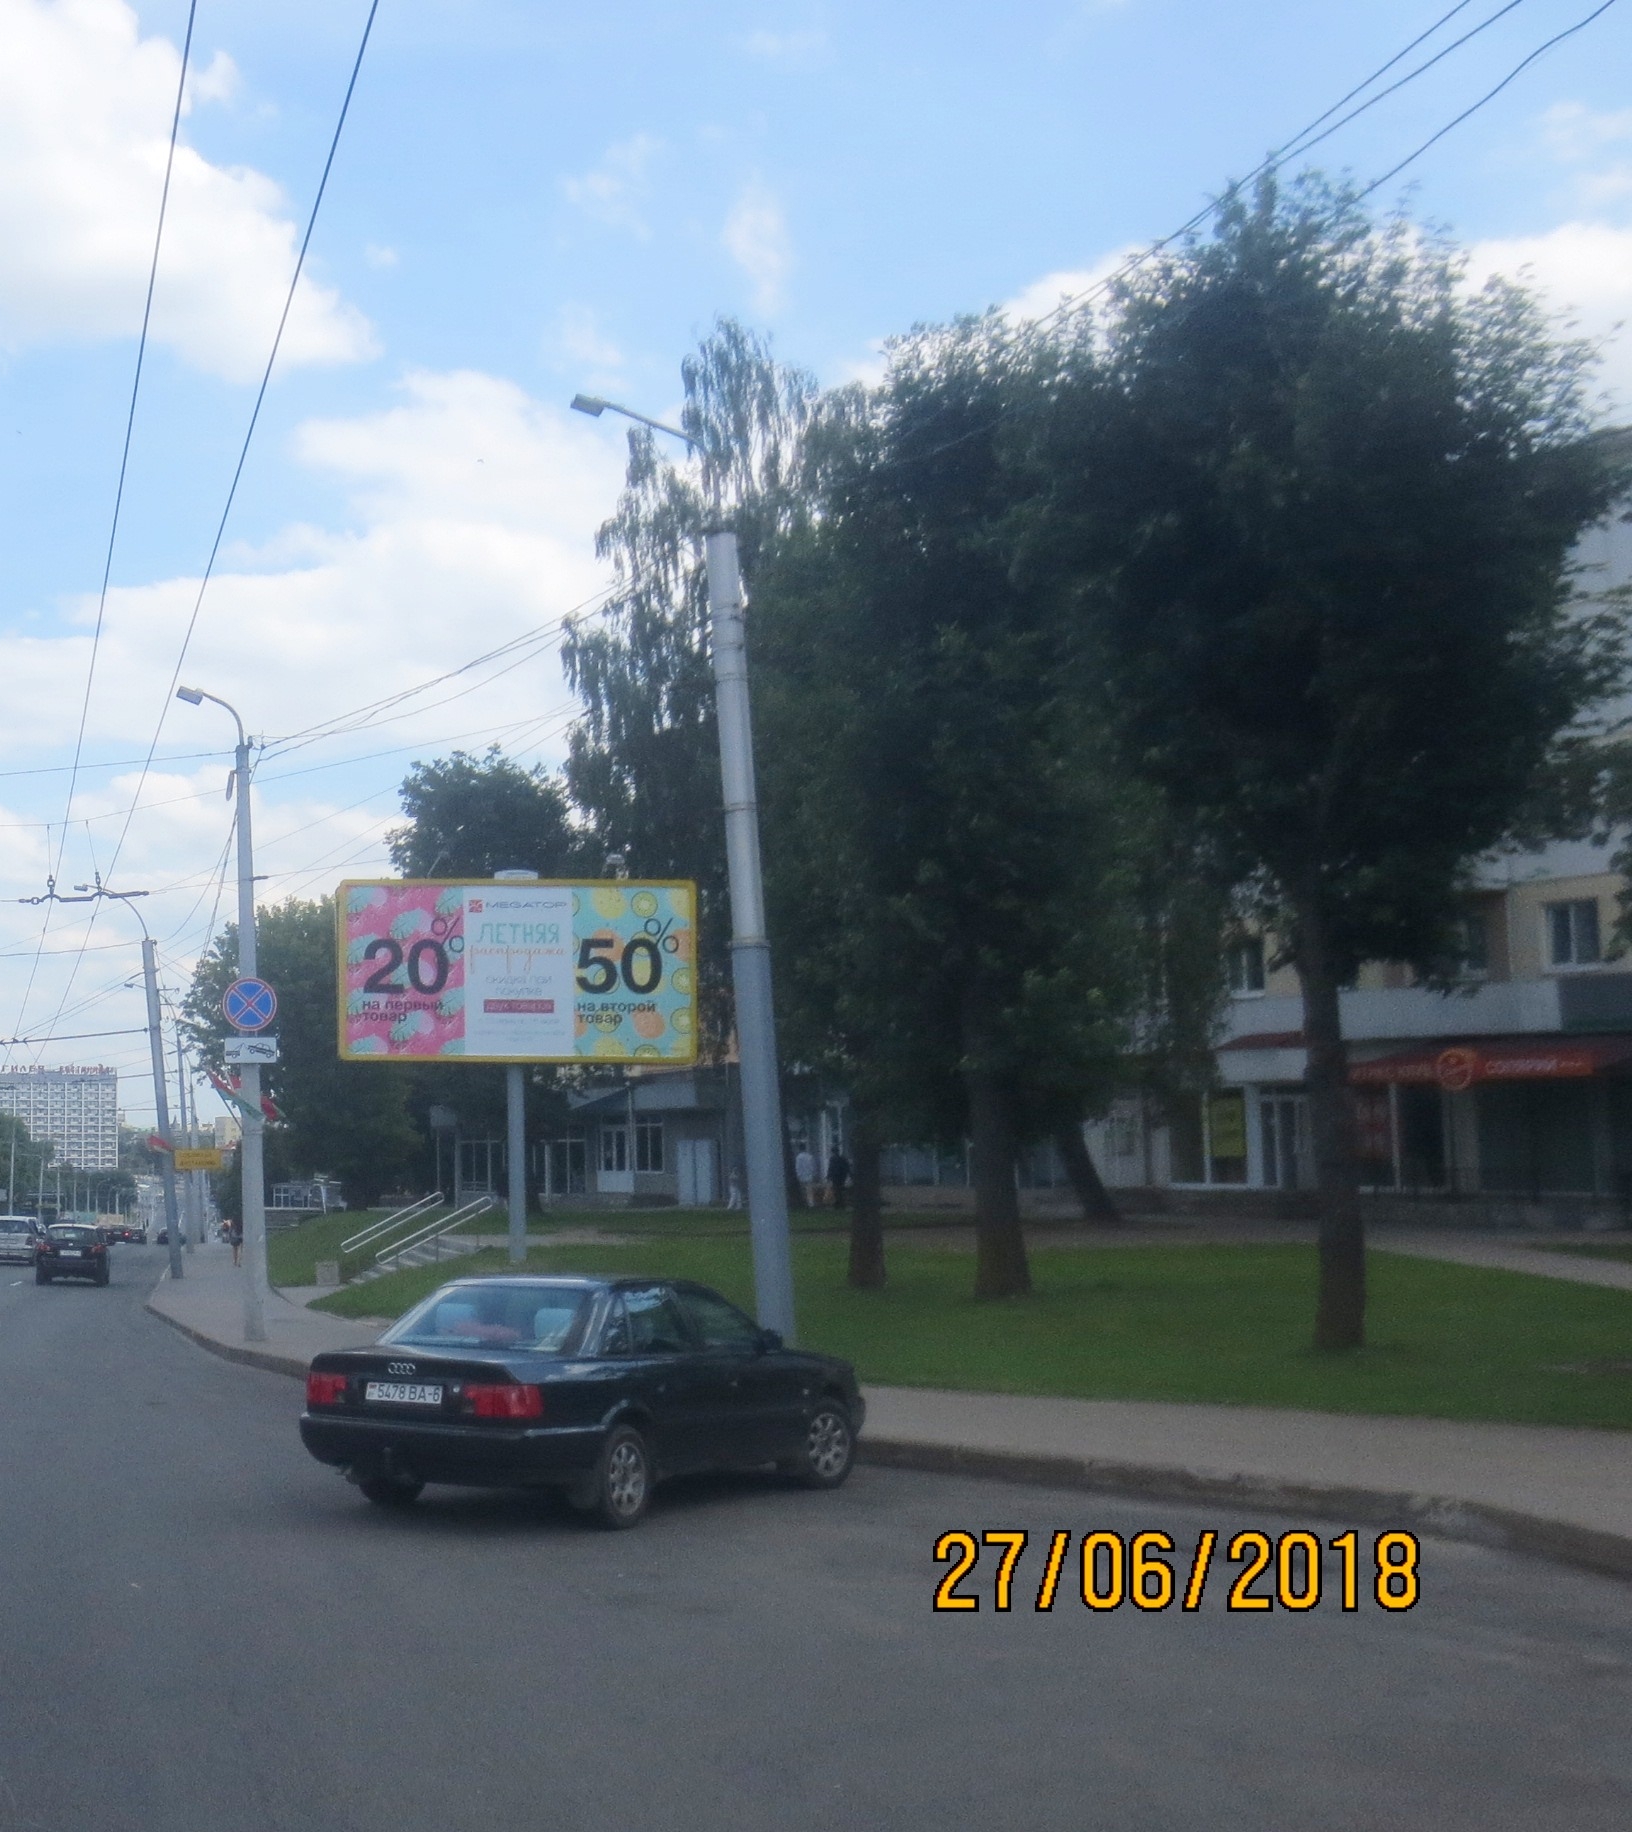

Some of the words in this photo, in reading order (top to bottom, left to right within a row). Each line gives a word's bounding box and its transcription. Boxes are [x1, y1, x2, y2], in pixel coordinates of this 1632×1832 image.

[485, 901, 567, 909] MEGATOP
[476, 922, 560, 944] ЛЕТНЯЯ
[363, 917, 465, 995] 20%
[576, 917, 679, 995] 50%
[362, 1000, 380, 1011] на
[385, 999, 444, 1013] первый
[577, 1002, 596, 1012] на
[601, 999, 656, 1015] второй
[362, 1012, 407, 1024] товар
[577, 1014, 623, 1026] товар
[377, 1383, 406, 1400] 5478
[409, 1385, 441, 1402] BA-6
